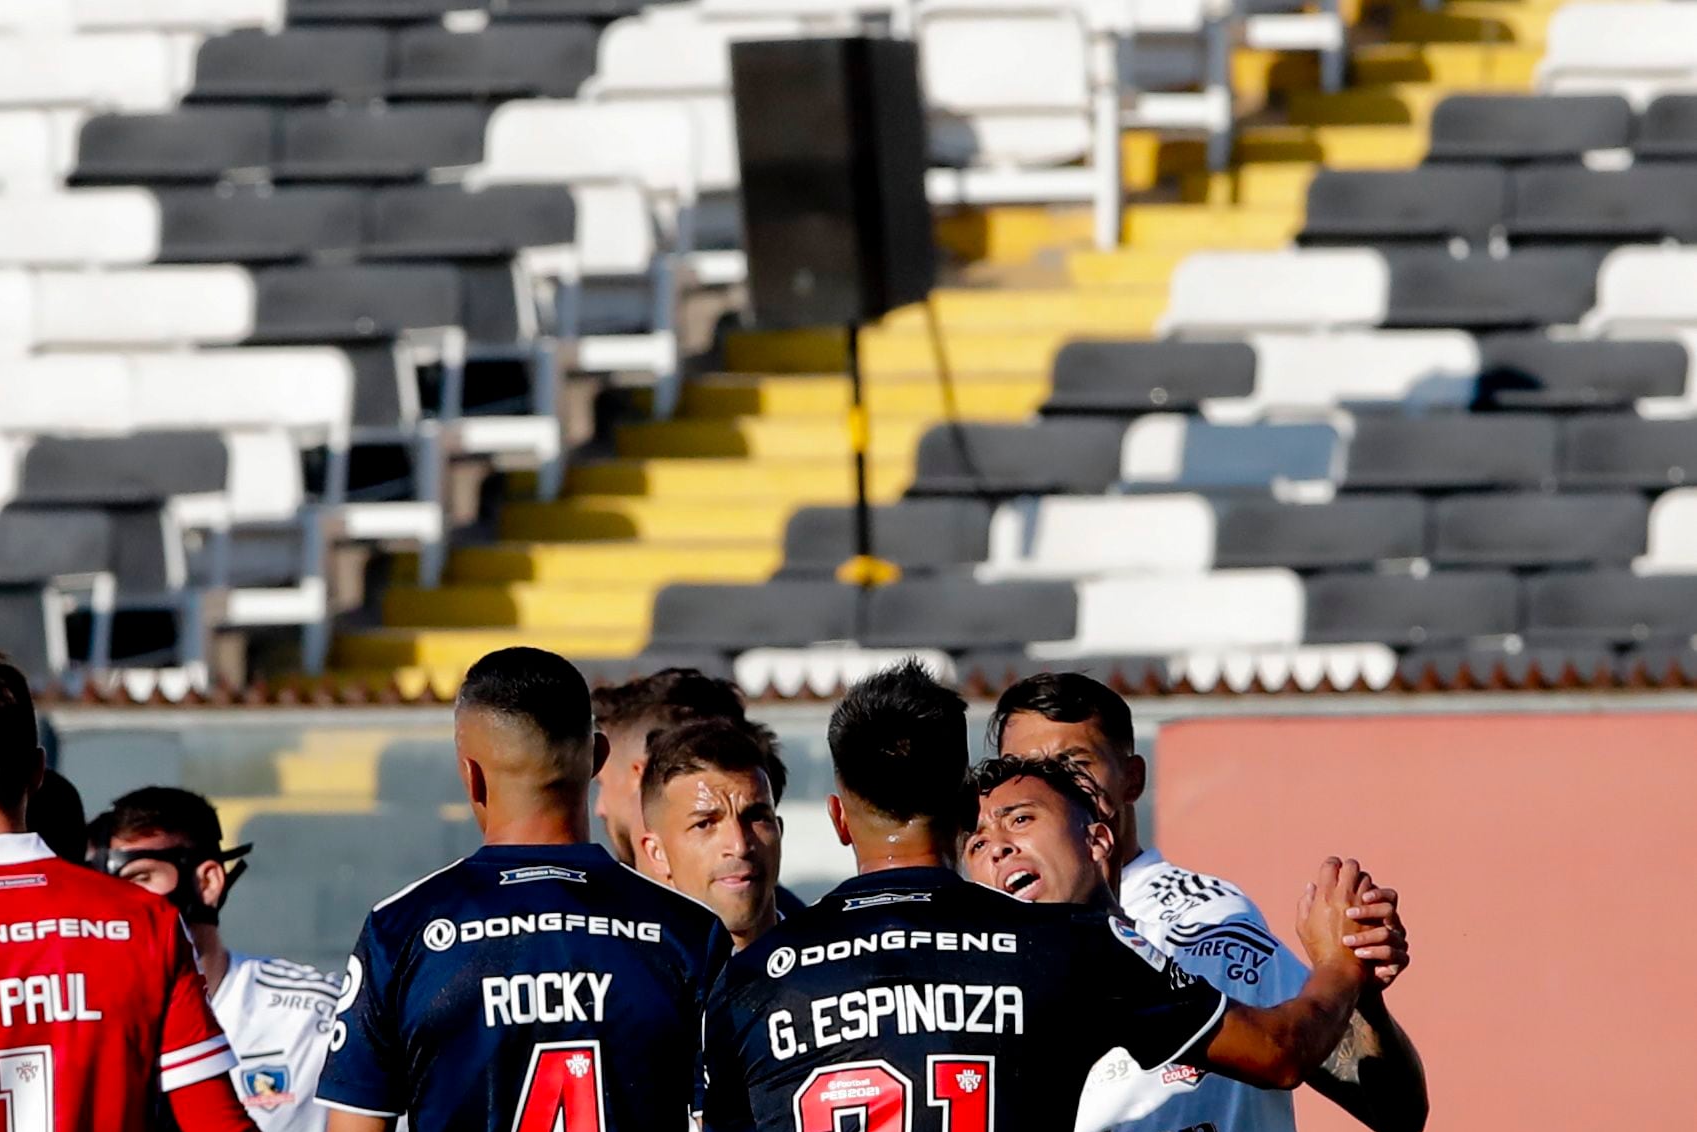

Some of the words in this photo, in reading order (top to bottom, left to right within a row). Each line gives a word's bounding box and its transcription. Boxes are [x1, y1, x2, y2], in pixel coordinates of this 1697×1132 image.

[460, 912, 662, 943] DONGFENG
[800, 930, 1017, 966] DONGFENG
[1183, 939, 1269, 970] IRECTV
[1226, 964, 1260, 985] GO
[482, 971, 613, 1028] ROCKY
[767, 1009, 808, 1061] G.
[810, 983, 1024, 1049] ESPINOZA
